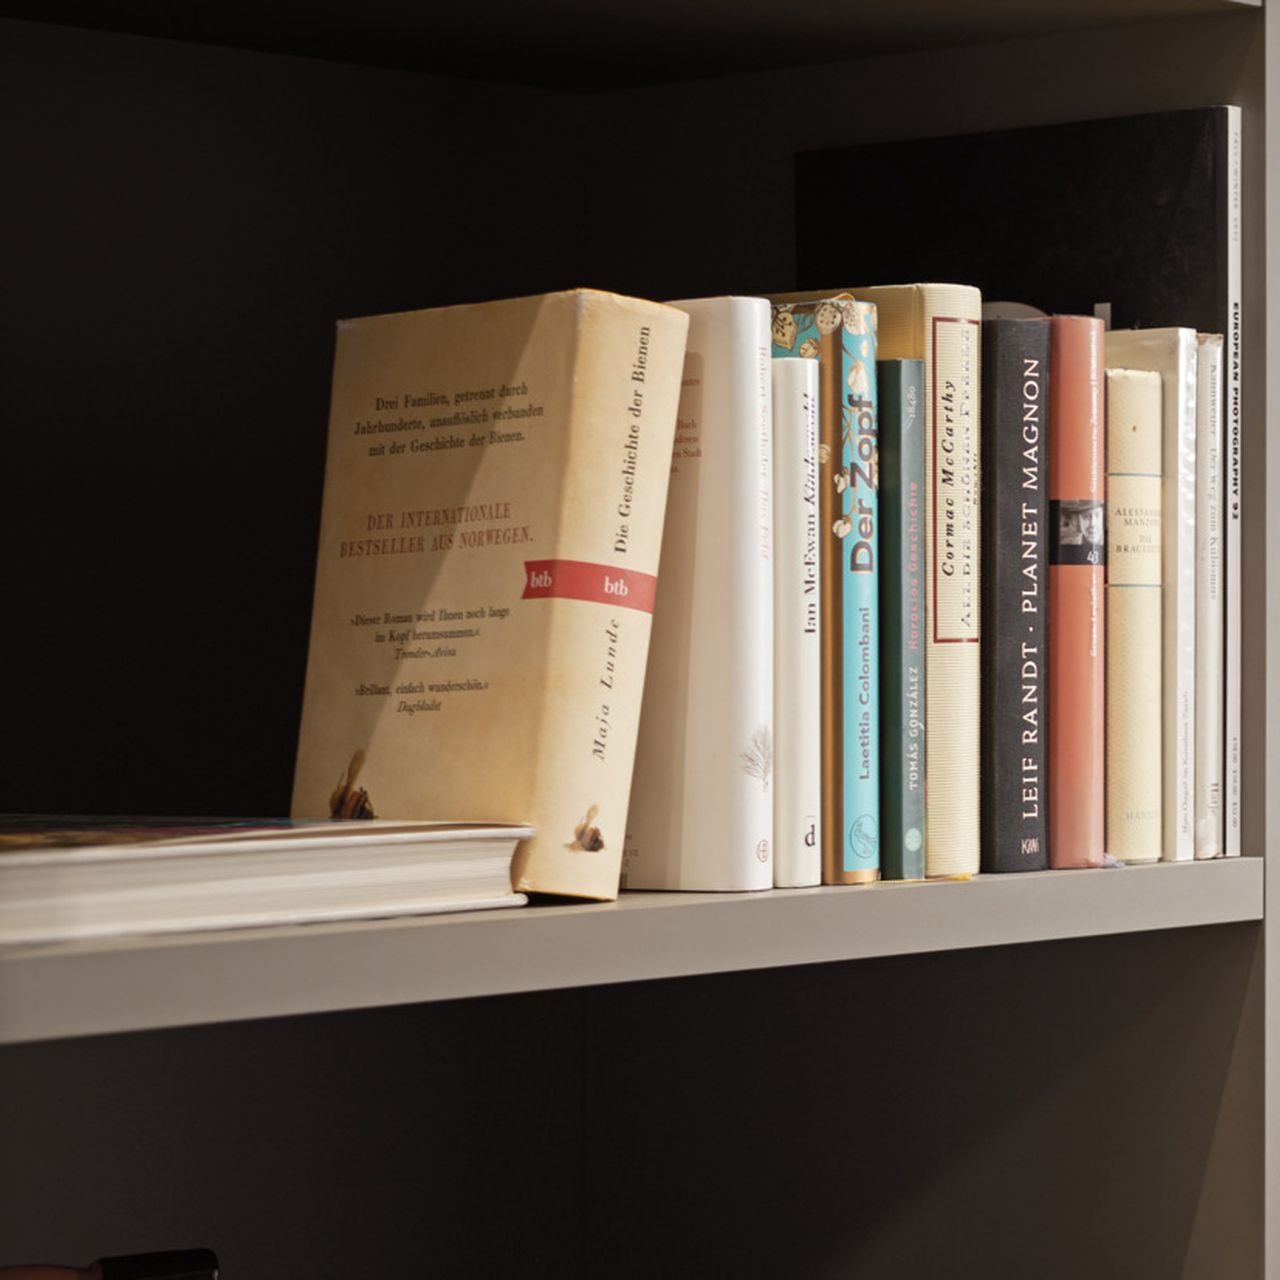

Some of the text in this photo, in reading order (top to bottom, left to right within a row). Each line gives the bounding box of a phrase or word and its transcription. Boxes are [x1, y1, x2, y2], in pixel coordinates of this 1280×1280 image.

[354, 418, 426, 436] Jahrhunderte,
[493, 403, 544, 421] verbunden
[375, 381, 528, 411] Drei Familien, getrennt durch
[1231, 301, 1240, 522] EUROPEAN PHOTOGRAPHY 92
[368, 430, 526, 457] mit der Geschichte der Bienen.
[613, 325, 651, 554] Die Geschichte der Bienen
[847, 393, 878, 573] Der Zopf
[940, 380, 957, 577] Cormac McCarthy
[1021, 358, 1040, 614] PLANET MAGNON
[340, 525, 534, 558] BESTSELLER AUS NORWEGEN.
[367, 501, 512, 531] DER INTERNATIONALE
[906, 481, 918, 573] Geschichte
[530, 571, 553, 588] btb
[803, 513, 816, 596] McEwan
[384, 612, 413, 624] Roman
[466, 605, 487, 619] noch
[488, 605, 511, 621] lange
[603, 576, 629, 598] btb
[388, 628, 411, 645] Kopf
[803, 602, 816, 634] Ian
[396, 681, 425, 694] einfach
[591, 619, 620, 762] Maja Lunde
[858, 607, 870, 780] Laetitia Colombani
[904, 665, 925, 791] TOMÁS GONZÁLEZ
[1021, 642, 1039, 820] LEIF RANDT
